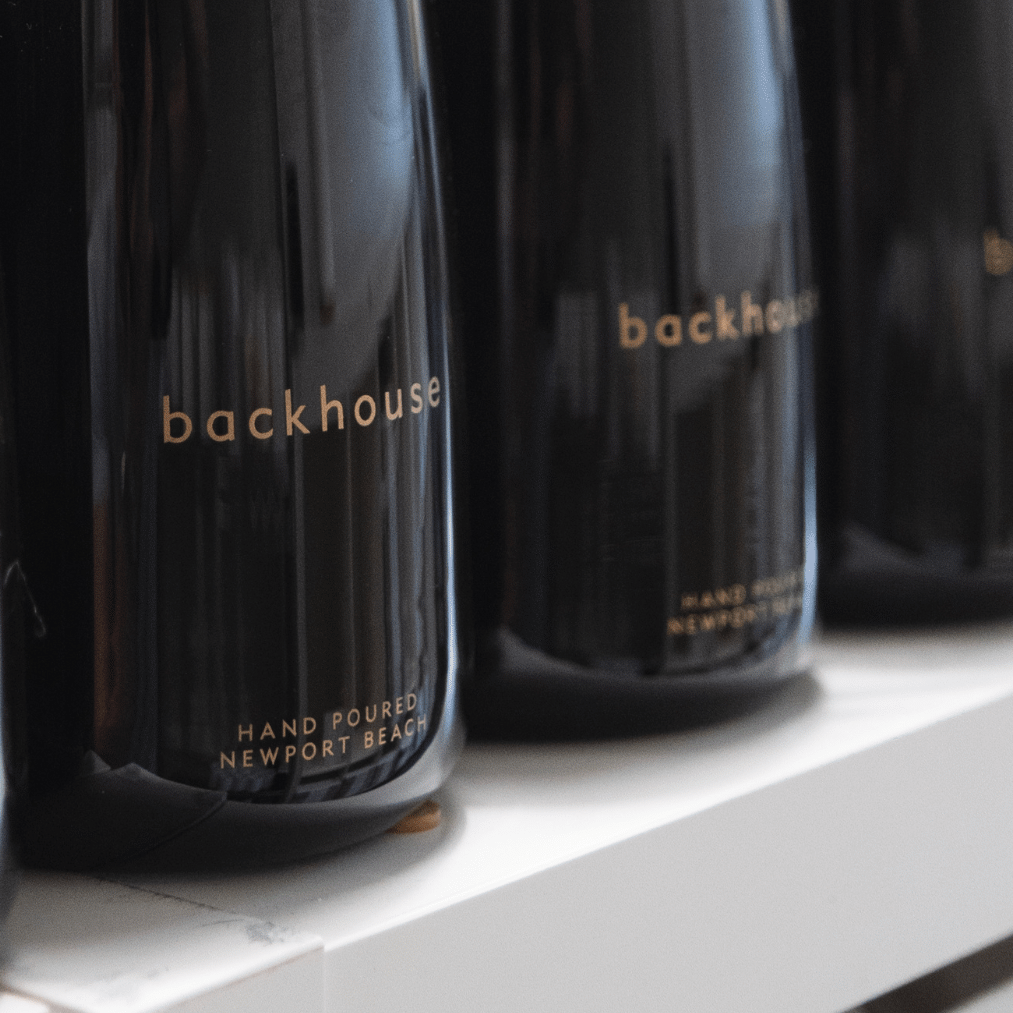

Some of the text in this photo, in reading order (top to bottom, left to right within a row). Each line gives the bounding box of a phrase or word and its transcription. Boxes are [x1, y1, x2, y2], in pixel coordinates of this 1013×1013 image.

[162, 376, 441, 443] backhouse
[219, 715, 427, 769] NEWPORT BEACH
[238, 693, 417, 742] HAND POURED
